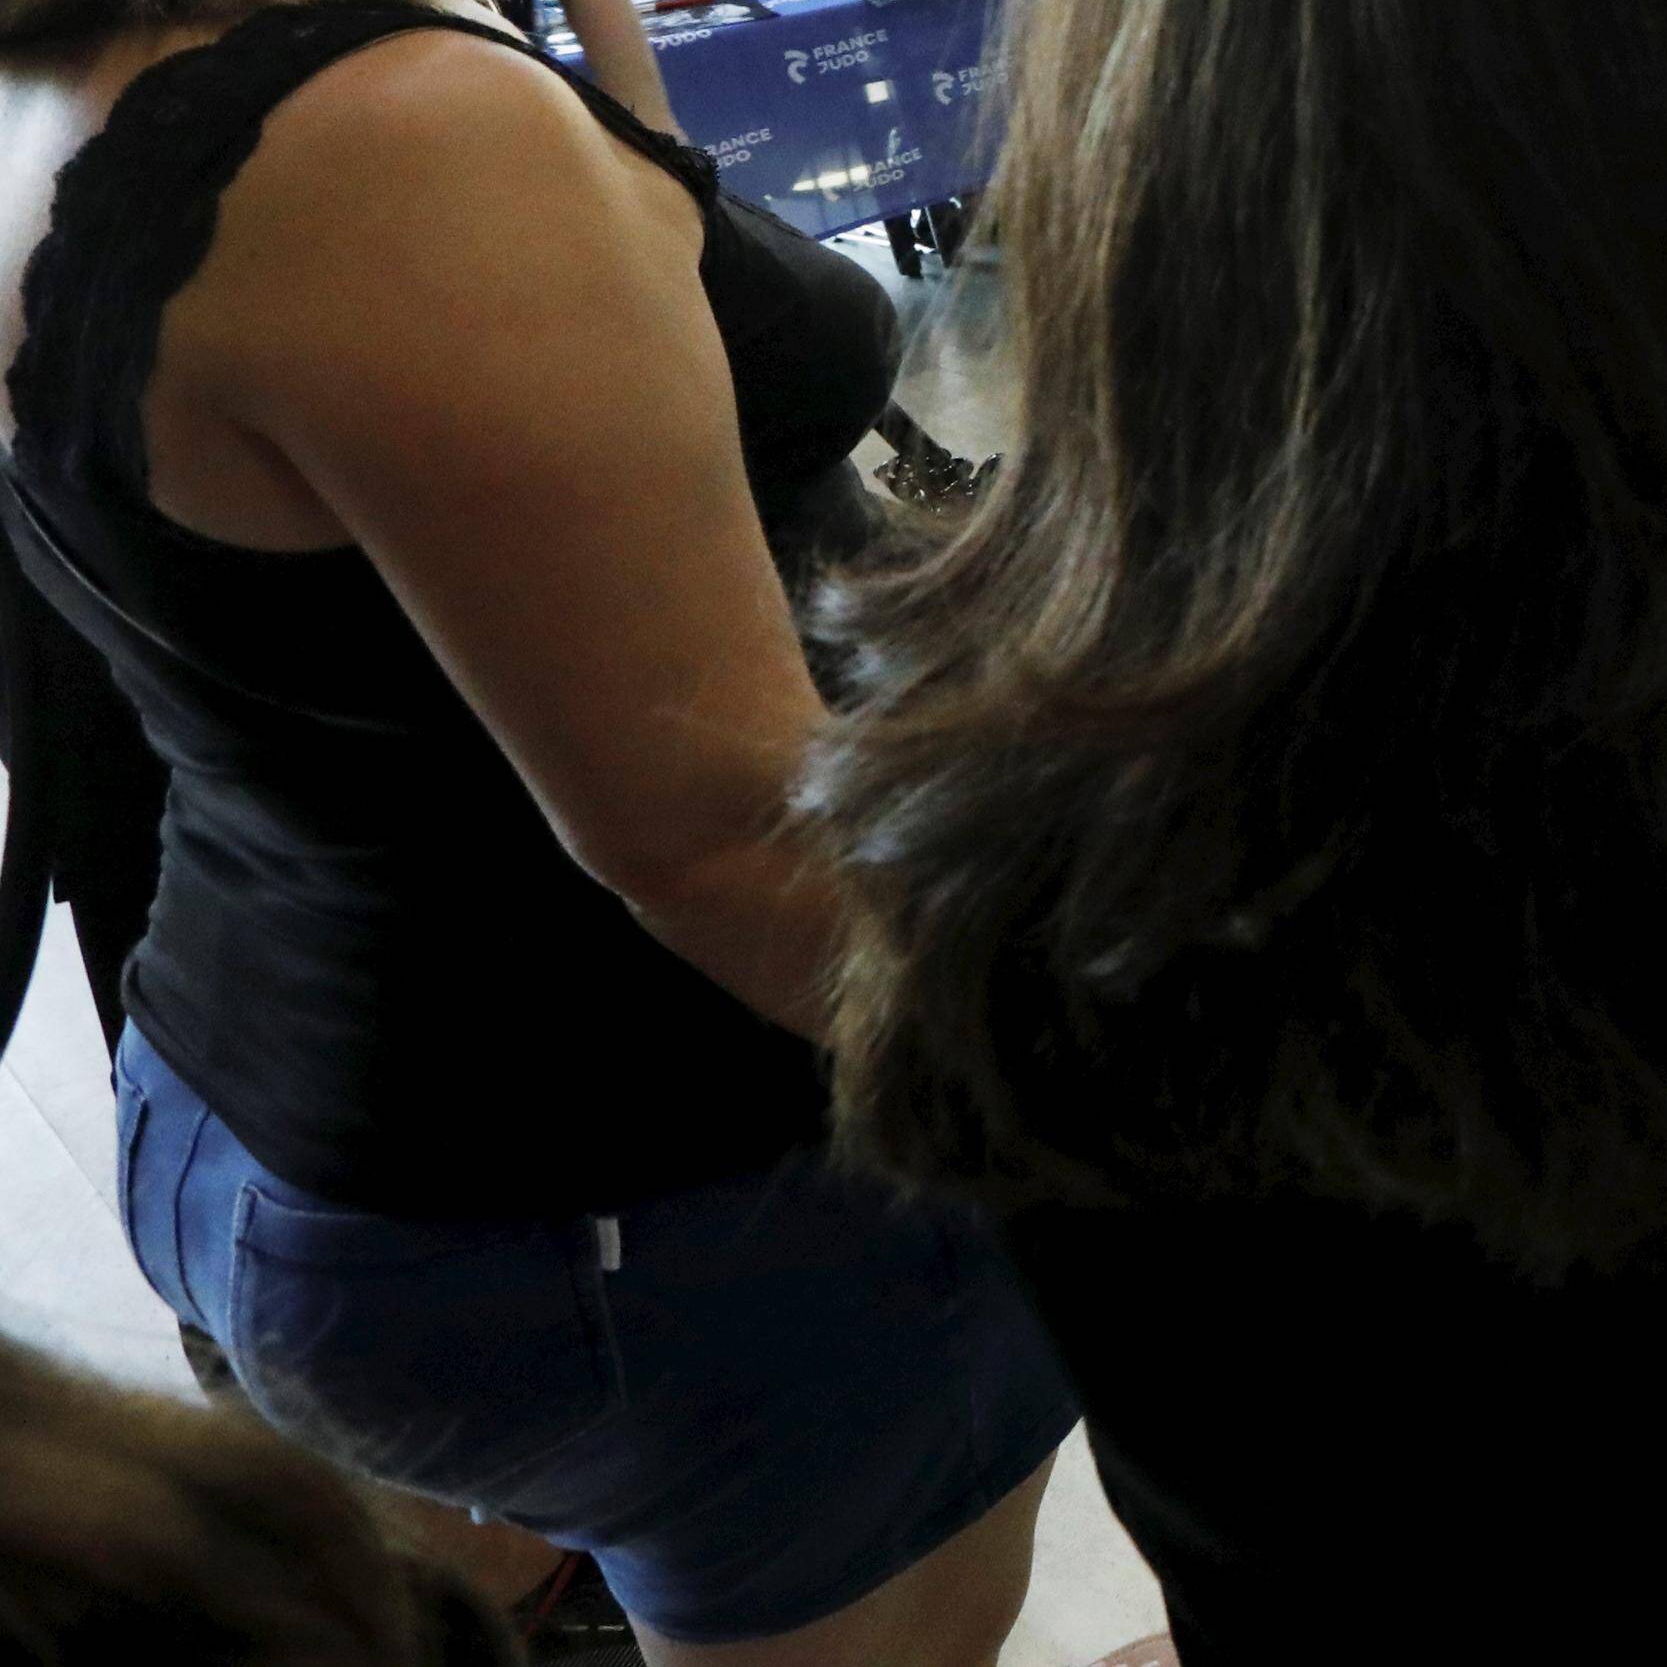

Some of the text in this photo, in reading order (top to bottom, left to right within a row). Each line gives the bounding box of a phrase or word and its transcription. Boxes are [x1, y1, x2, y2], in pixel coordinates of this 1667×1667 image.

[812, 29, 889, 60] FRANCE
[817, 50, 870, 75] JUDO
[703, 128, 773, 156] RANCE
